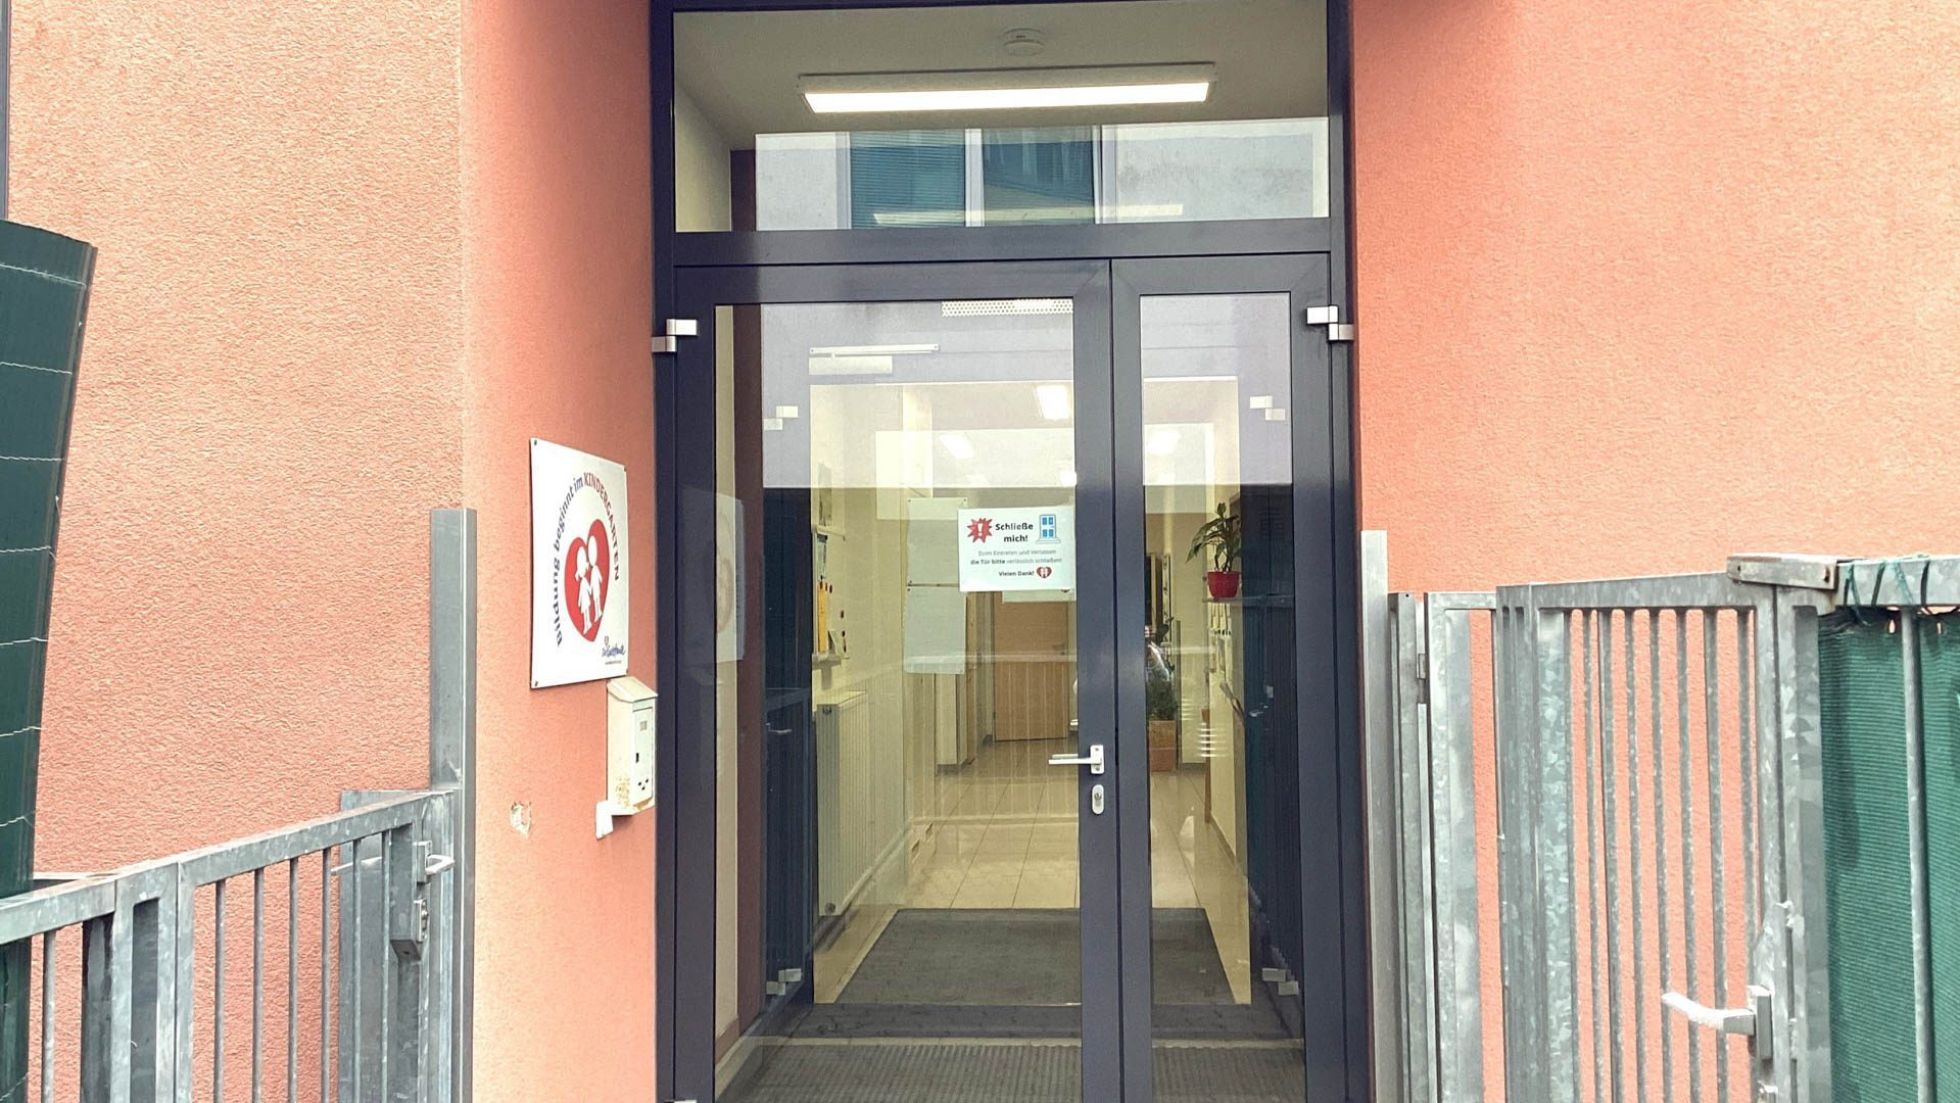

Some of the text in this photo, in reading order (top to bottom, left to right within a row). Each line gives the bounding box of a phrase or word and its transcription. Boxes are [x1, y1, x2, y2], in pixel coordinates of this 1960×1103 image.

[995, 522, 1034, 531] Schließe
[1003, 534, 1029, 543] mich!
[553, 472, 619, 647] Bildung beginnt im KINDERGARTEN
